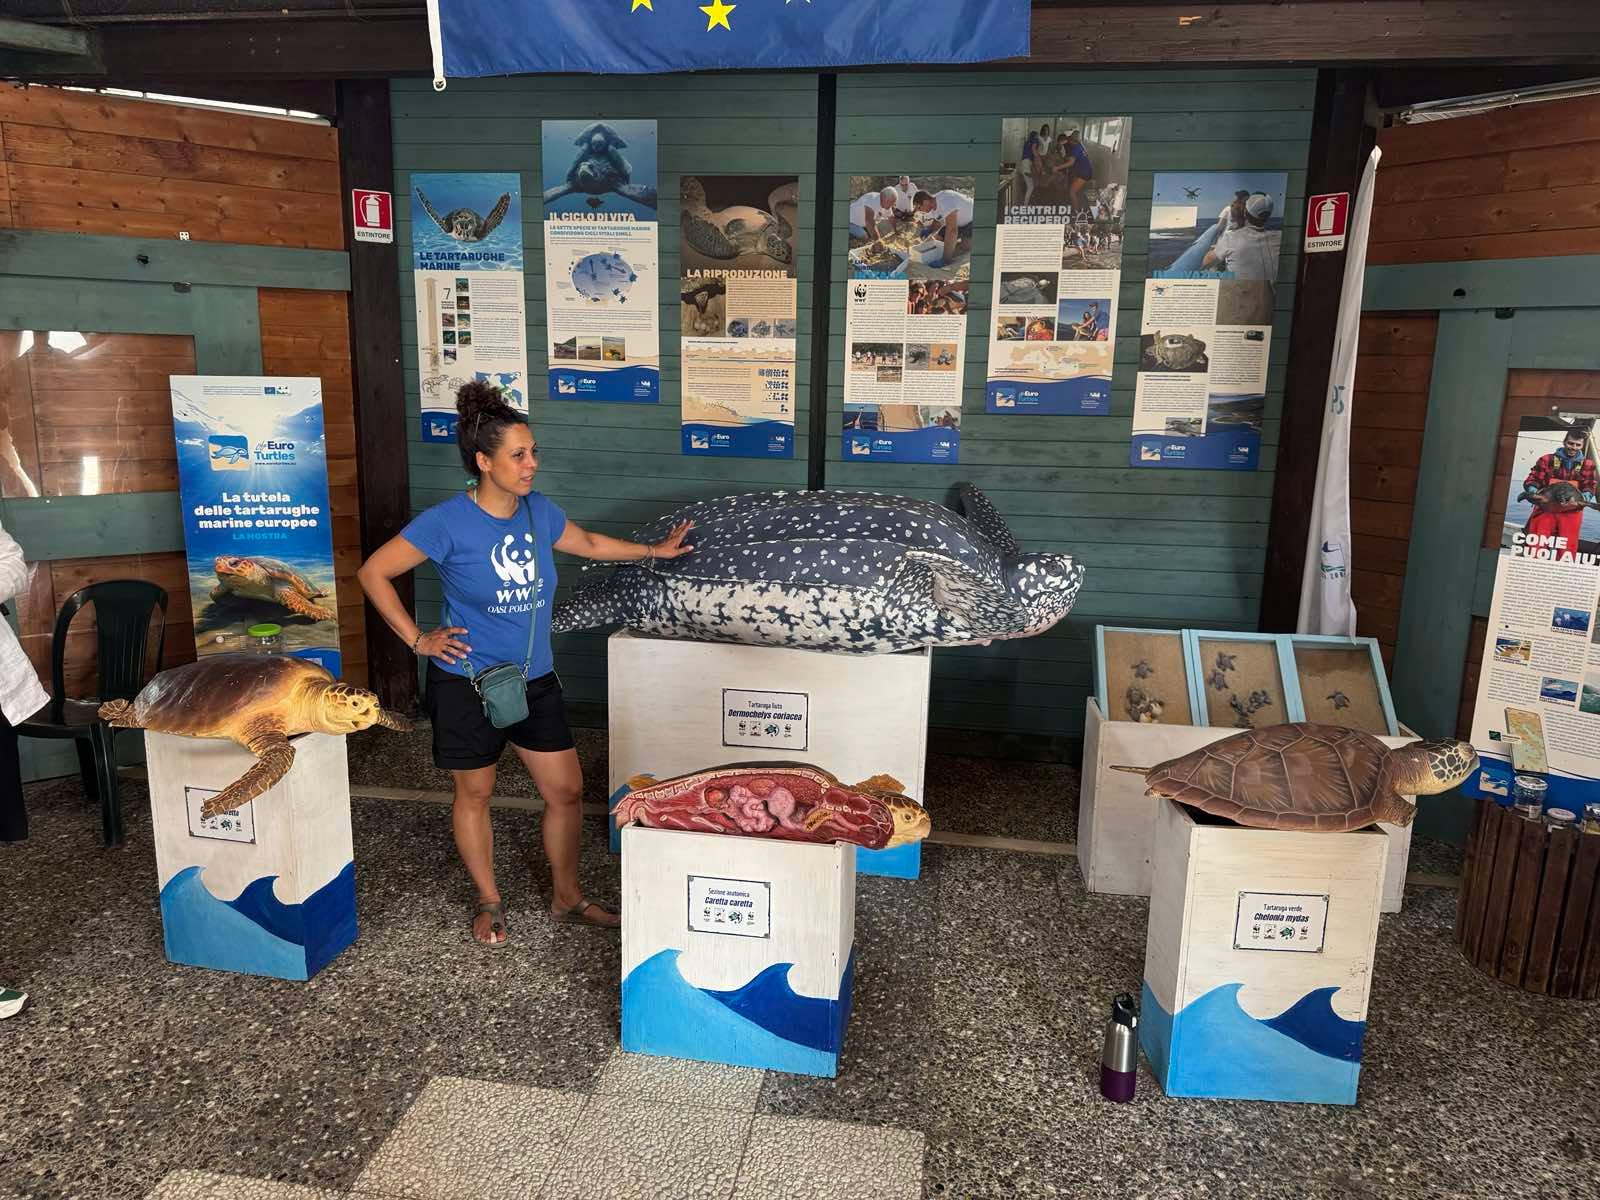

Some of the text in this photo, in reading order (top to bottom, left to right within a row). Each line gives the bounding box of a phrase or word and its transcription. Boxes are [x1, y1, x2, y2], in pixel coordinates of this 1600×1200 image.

[1005, 206, 1071, 215] I CENTRI DI
[550, 212, 636, 222] IL CICLO DI VITA
[1004, 216, 1070, 224] RECUPERO
[357, 231, 391, 239] ESTINTORE
[1308, 240, 1342, 248] ESTINTORE
[420, 252, 504, 262] LE TARTARUGHE
[420, 262, 460, 270] MARINE
[686, 269, 788, 280] LA RIPRODUZIONE
[443, 288, 450, 300] 7
[268, 440, 294, 450] Euro
[254, 451, 296, 460] Turtles
[222, 492, 290, 502] La tutela
[194, 504, 320, 517] delle tartarughe
[199, 518, 317, 530] marine europee
[1512, 532, 1568, 549] COME
[1510, 544, 1557, 562] PUOI
[488, 605, 507, 614] OASI
[748, 701, 771, 710] Tartaruga
[728, 709, 802, 720] Dermochelys coriacea
[708, 888, 726, 896] Sezione
[704, 896, 753, 908] Caretta caretta
[1264, 904, 1288, 912] Tartaruga
[1254, 912, 1310, 923] Chelonia mydas
